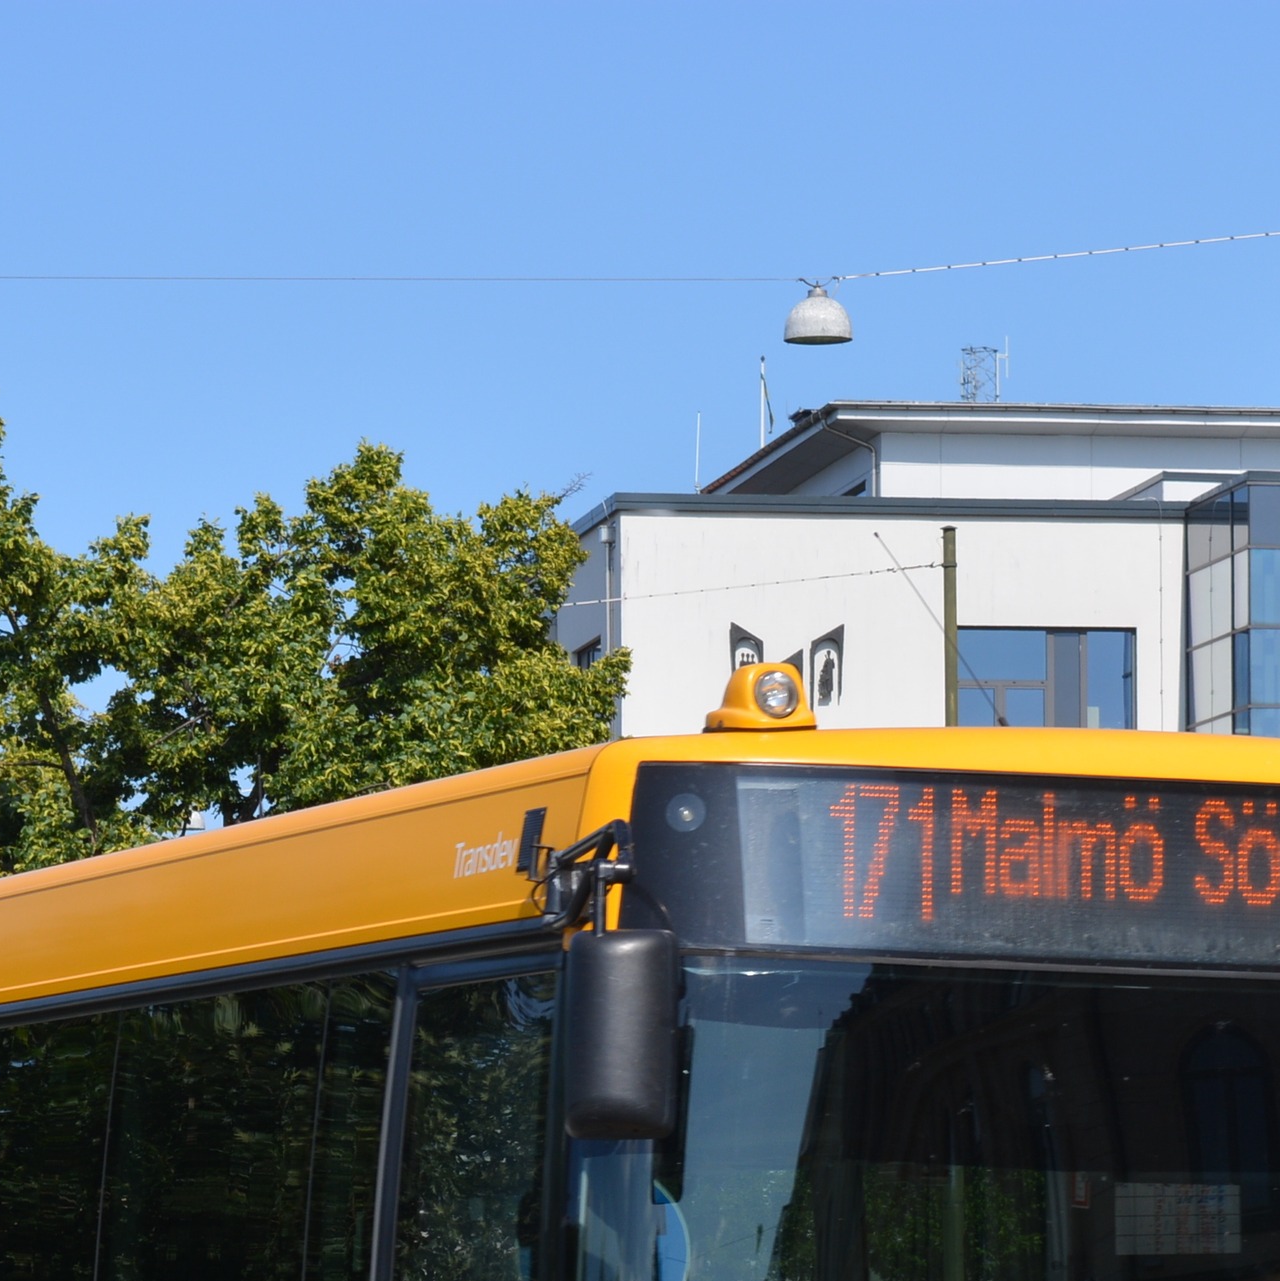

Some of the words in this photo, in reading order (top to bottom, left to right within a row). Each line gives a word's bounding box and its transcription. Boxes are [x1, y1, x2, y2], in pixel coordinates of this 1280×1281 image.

[453, 830, 519, 880] Transdev
[829, 783, 933, 921] 171
[950, 788, 1164, 901] Malmö
